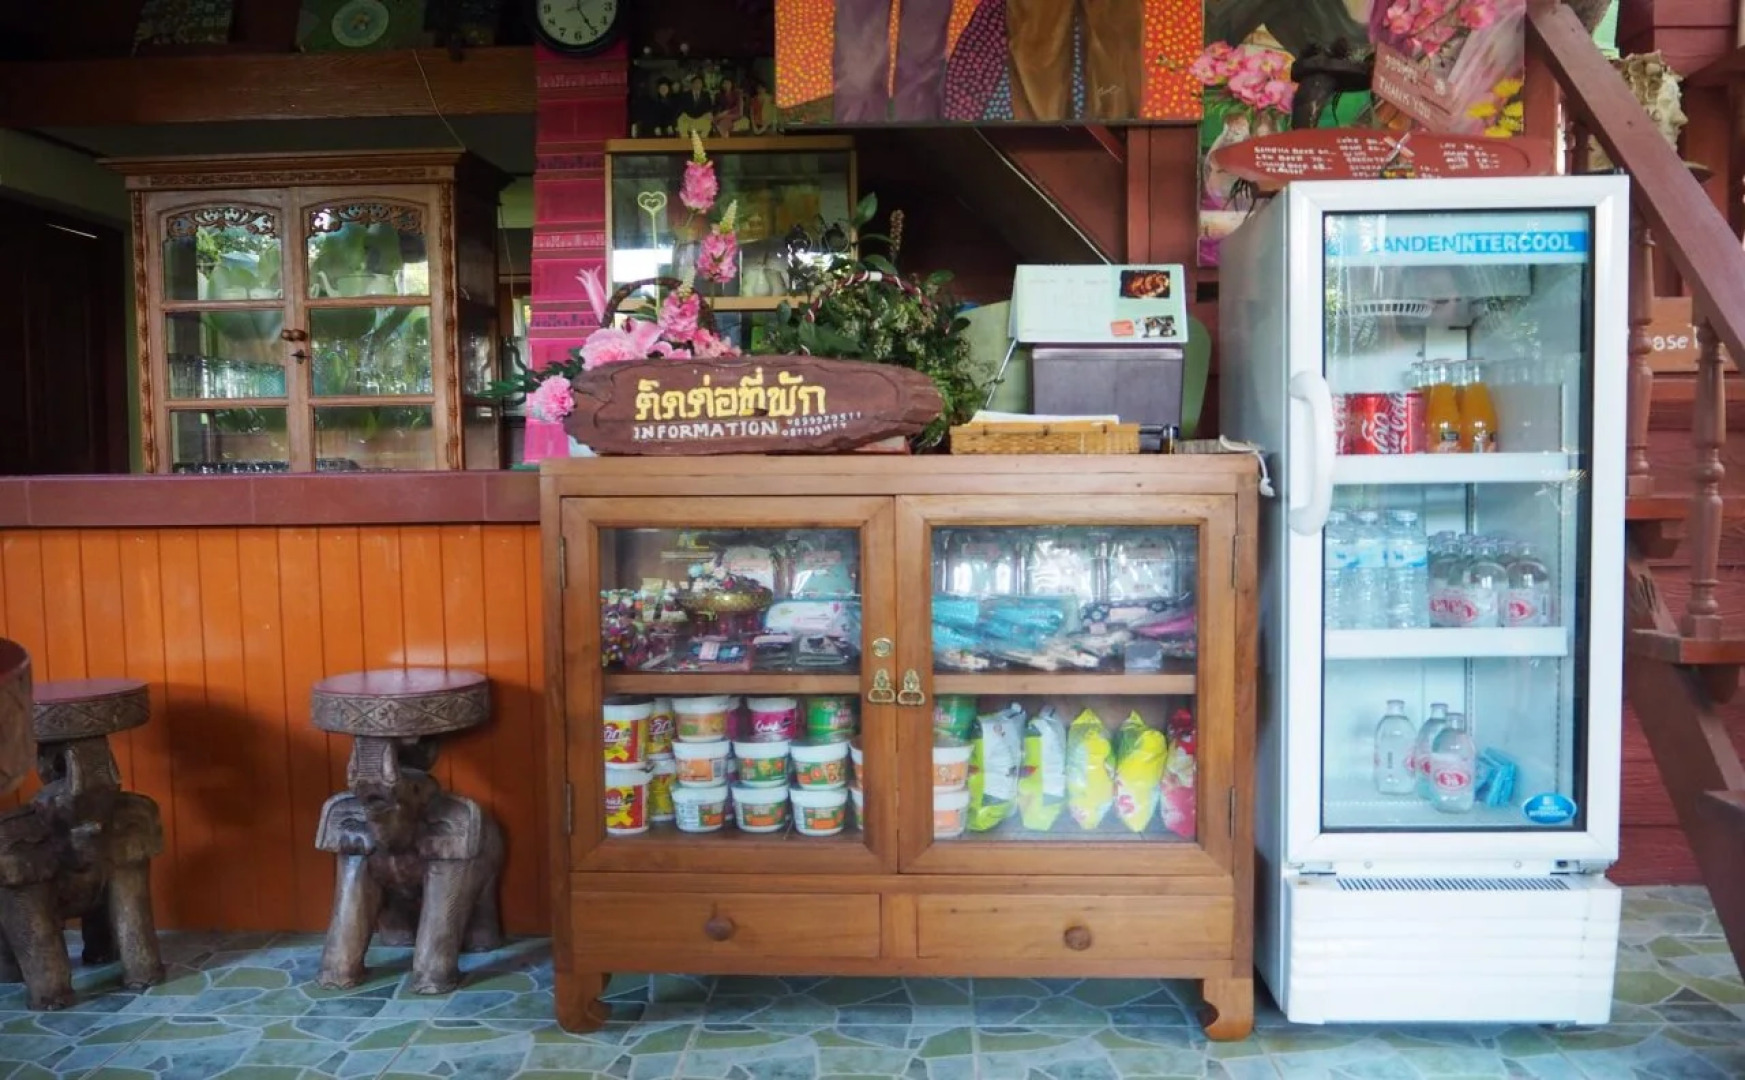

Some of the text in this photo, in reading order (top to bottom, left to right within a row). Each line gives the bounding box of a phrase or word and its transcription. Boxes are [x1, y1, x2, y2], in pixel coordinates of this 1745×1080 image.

[1652, 335, 1690, 352] ase
[634, 367, 826, 421] ติดต่อที่พัก
[633, 420, 778, 440] INFORMATION
